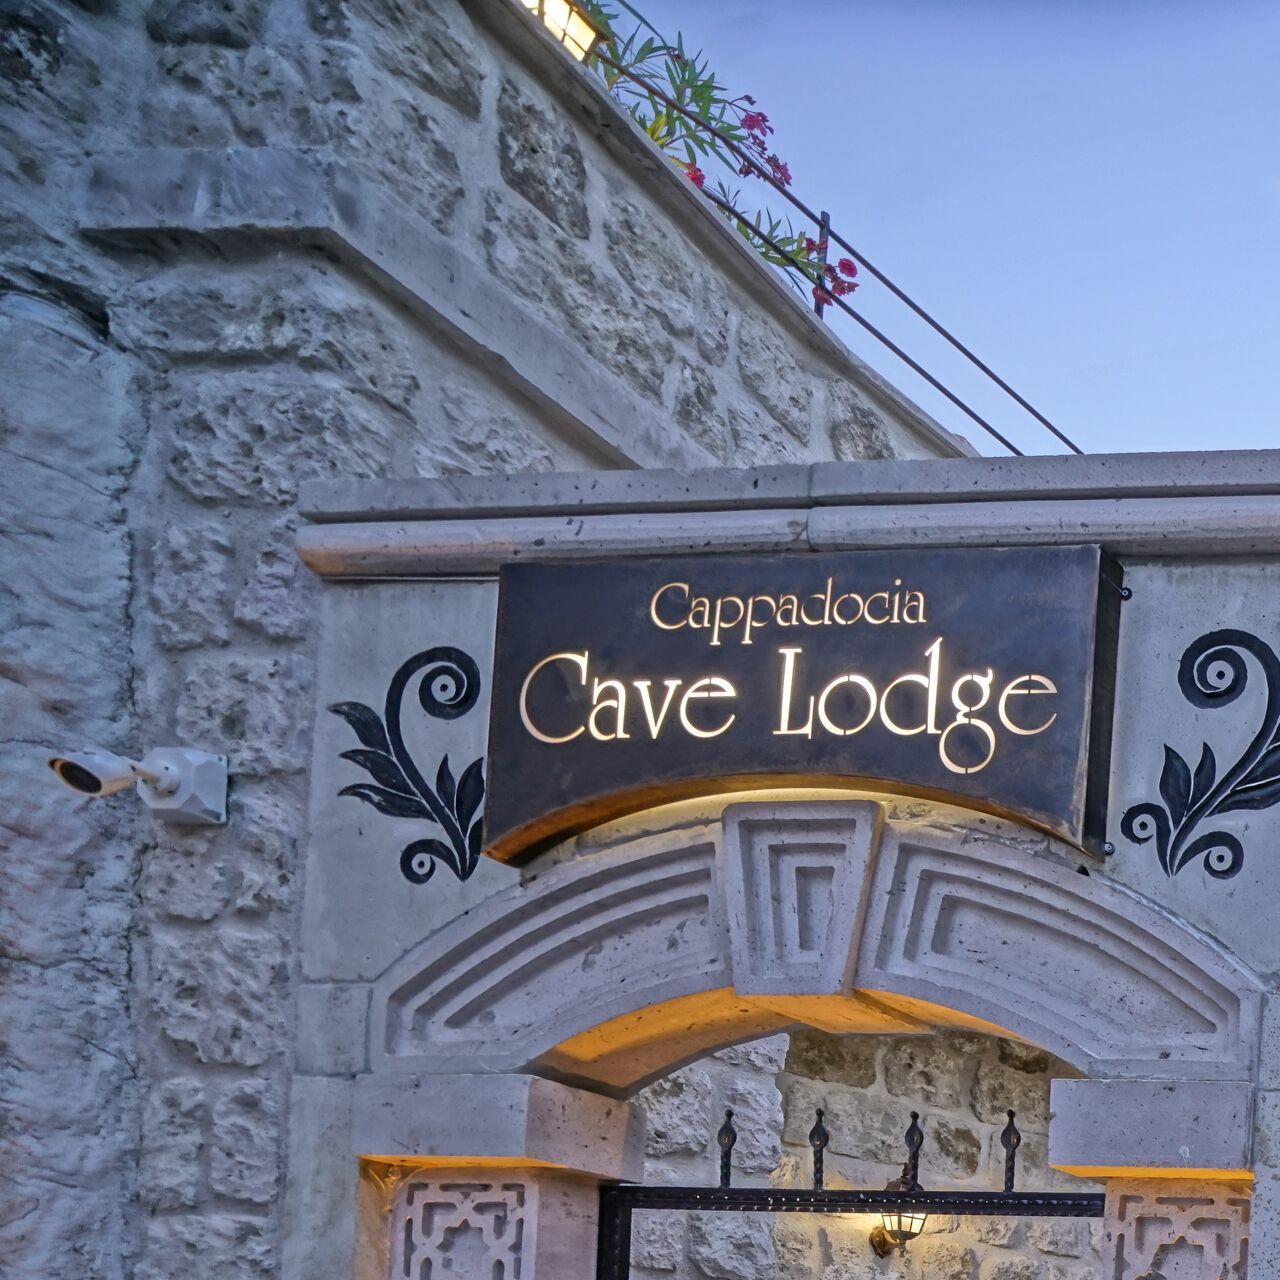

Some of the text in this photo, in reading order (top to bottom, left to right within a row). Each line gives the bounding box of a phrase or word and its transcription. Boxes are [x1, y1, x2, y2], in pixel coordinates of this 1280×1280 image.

[650, 577, 927, 645] Cappadocia
[519, 637, 1058, 774] Cave Lodge
